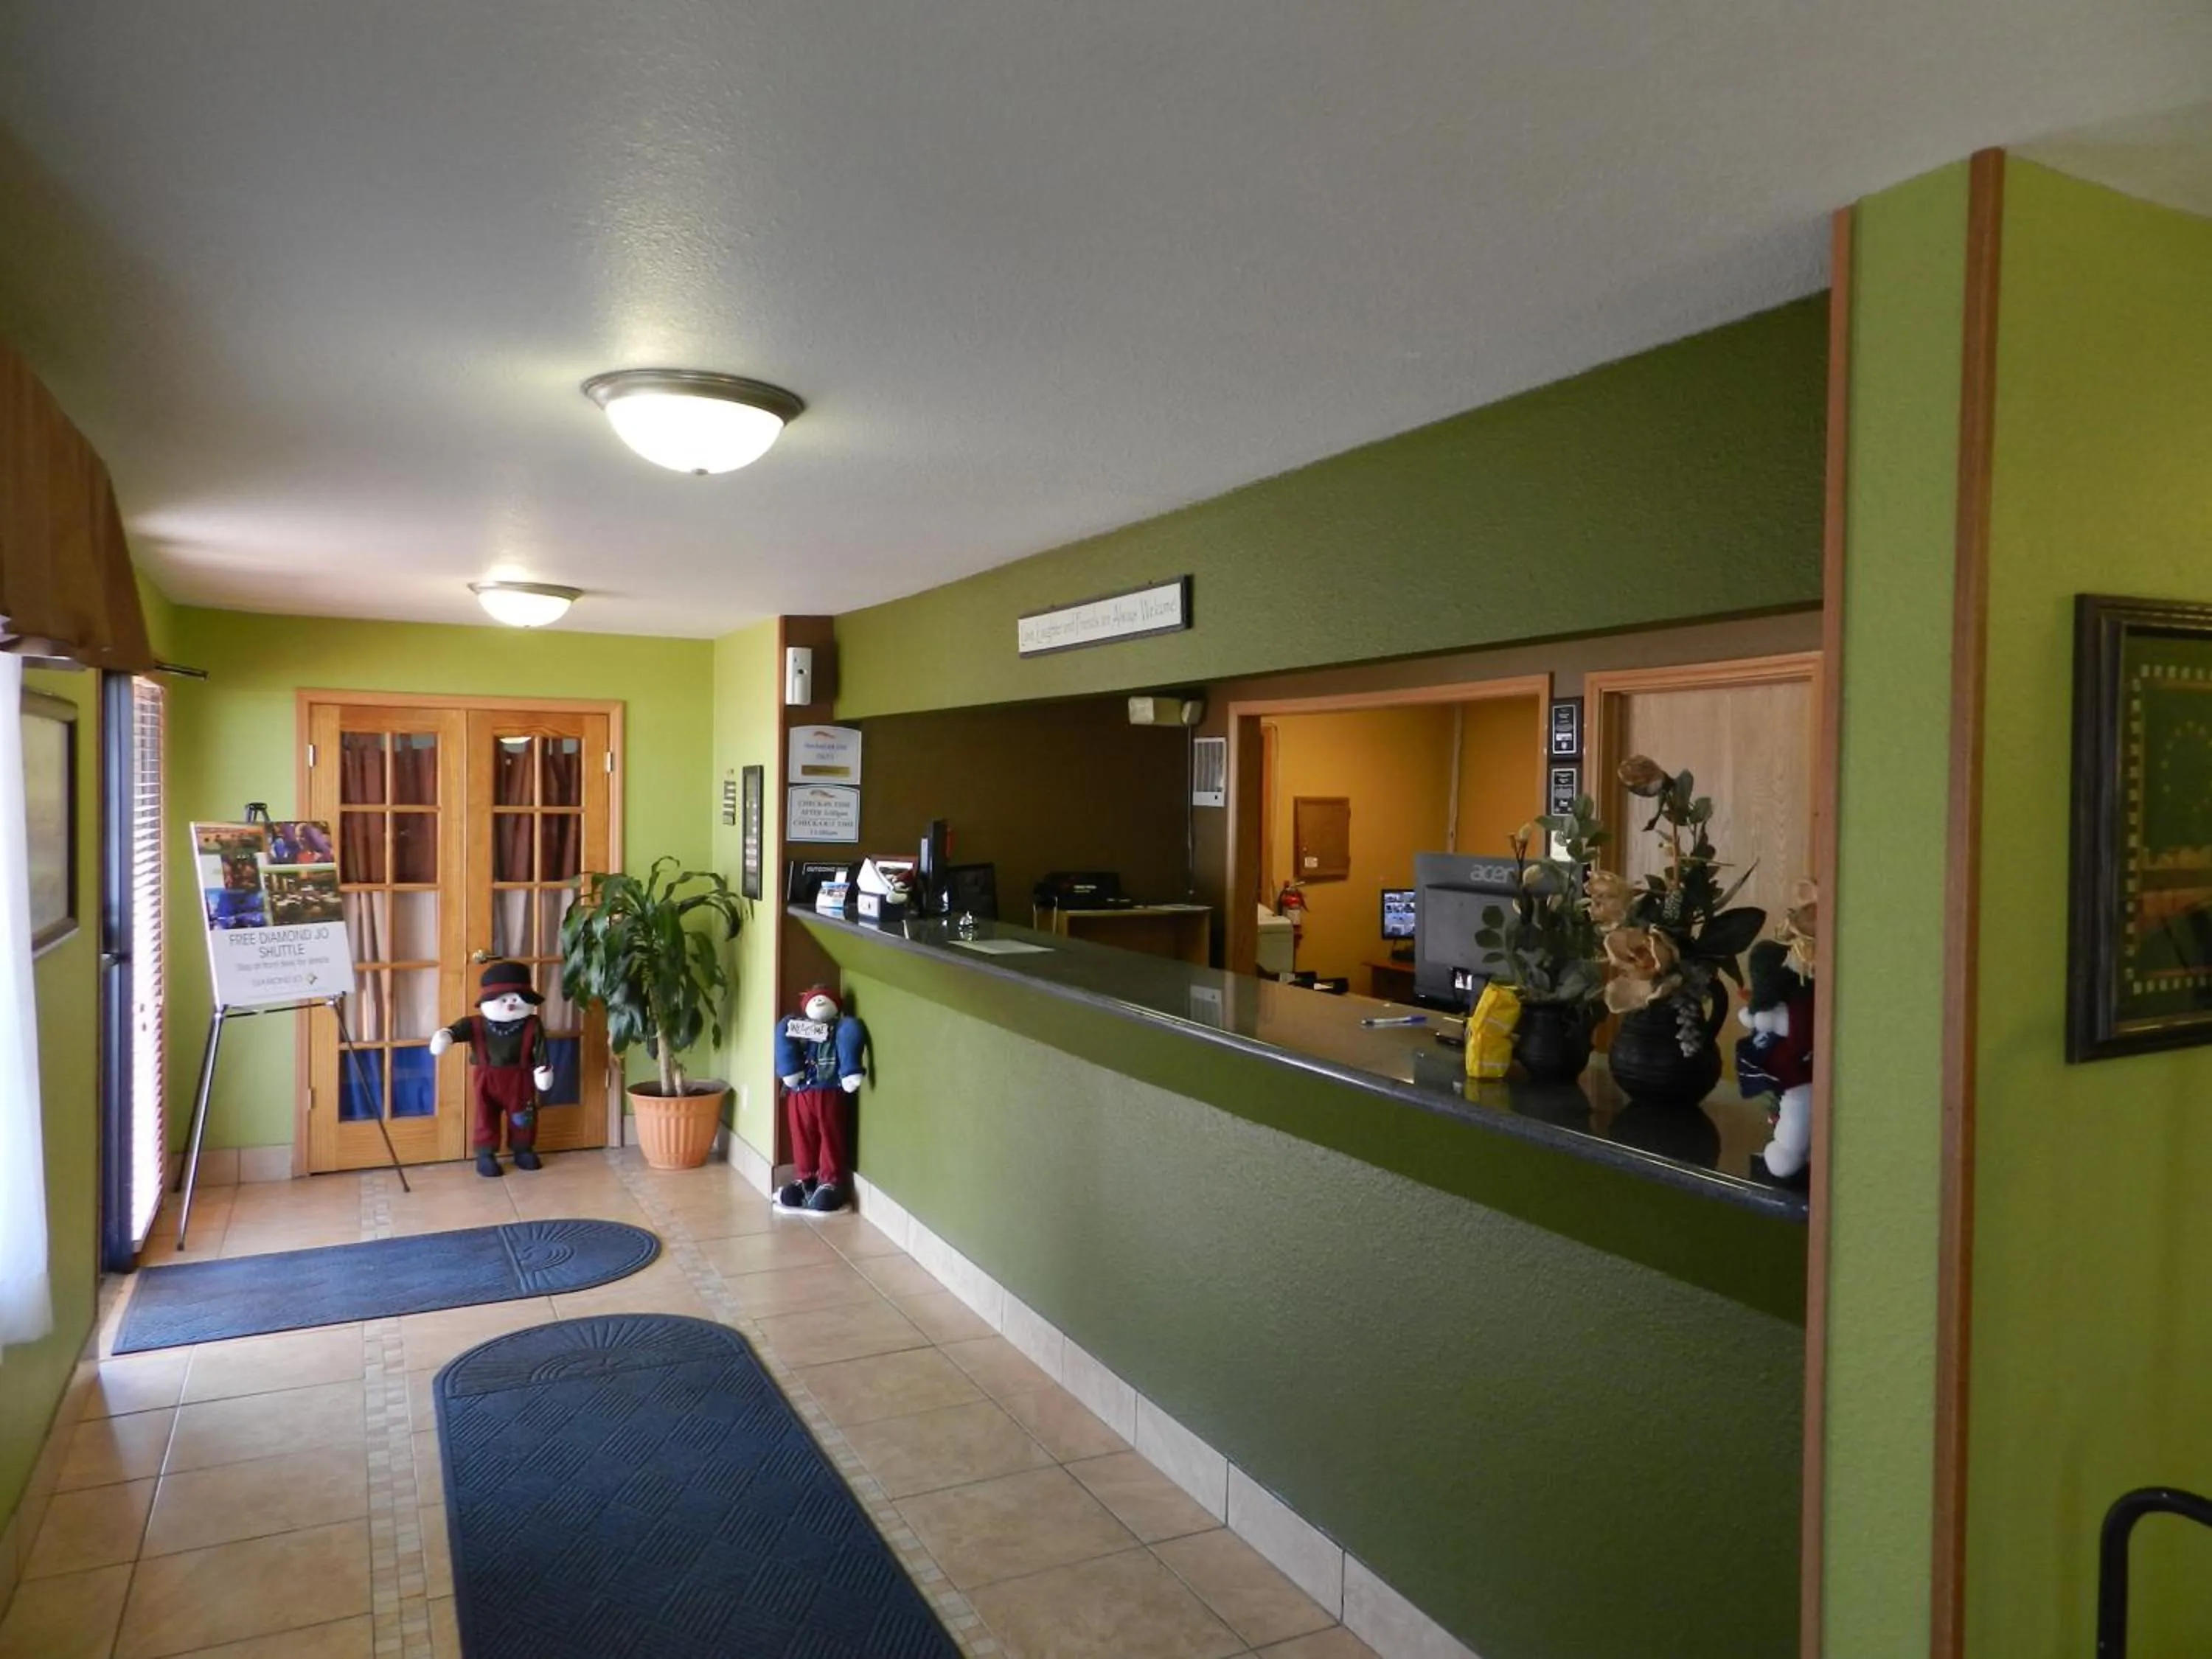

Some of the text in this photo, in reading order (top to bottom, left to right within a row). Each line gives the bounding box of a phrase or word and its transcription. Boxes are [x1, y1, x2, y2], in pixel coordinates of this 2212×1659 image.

[1470, 863, 1514, 883] acer
[229, 926, 330, 946] FREE DIAMOND JO
[259, 944, 306, 959] SHUTTLE
